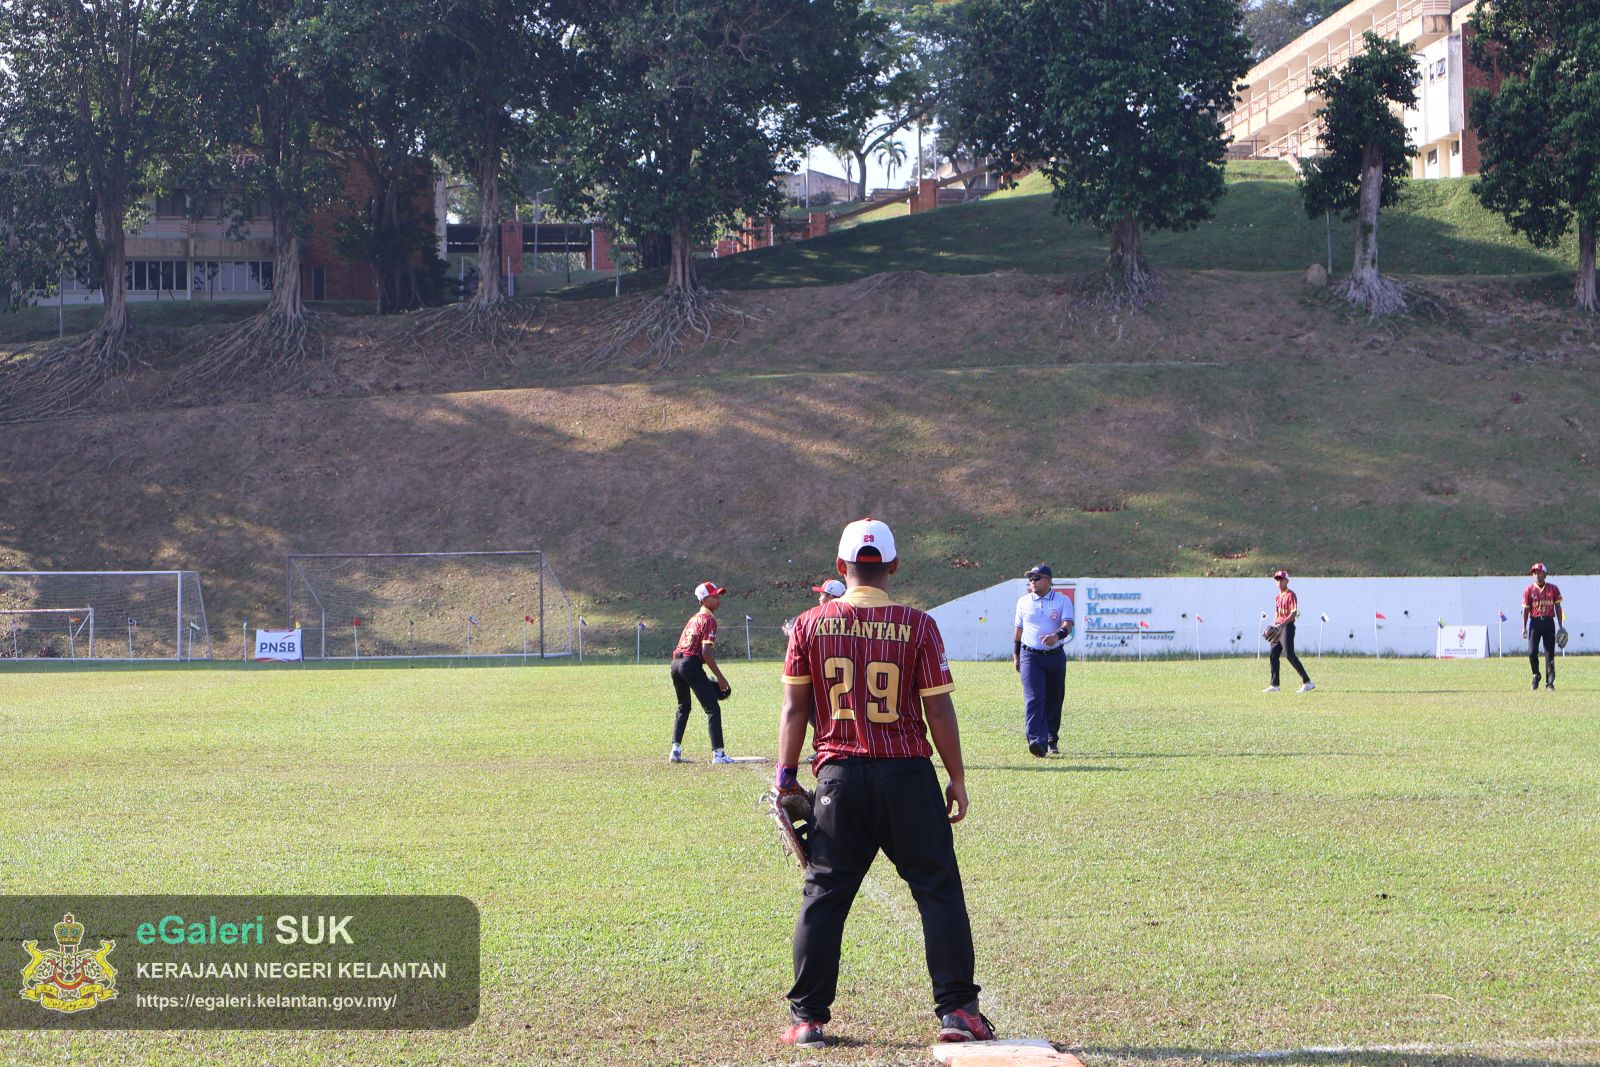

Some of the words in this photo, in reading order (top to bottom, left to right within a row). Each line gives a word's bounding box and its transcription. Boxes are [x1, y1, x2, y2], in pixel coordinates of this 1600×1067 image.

[863, 534, 875, 543] 29
[814, 617, 913, 643] KELANTAN
[260, 642, 295, 652] PNSB
[823, 656, 900, 724] 29
